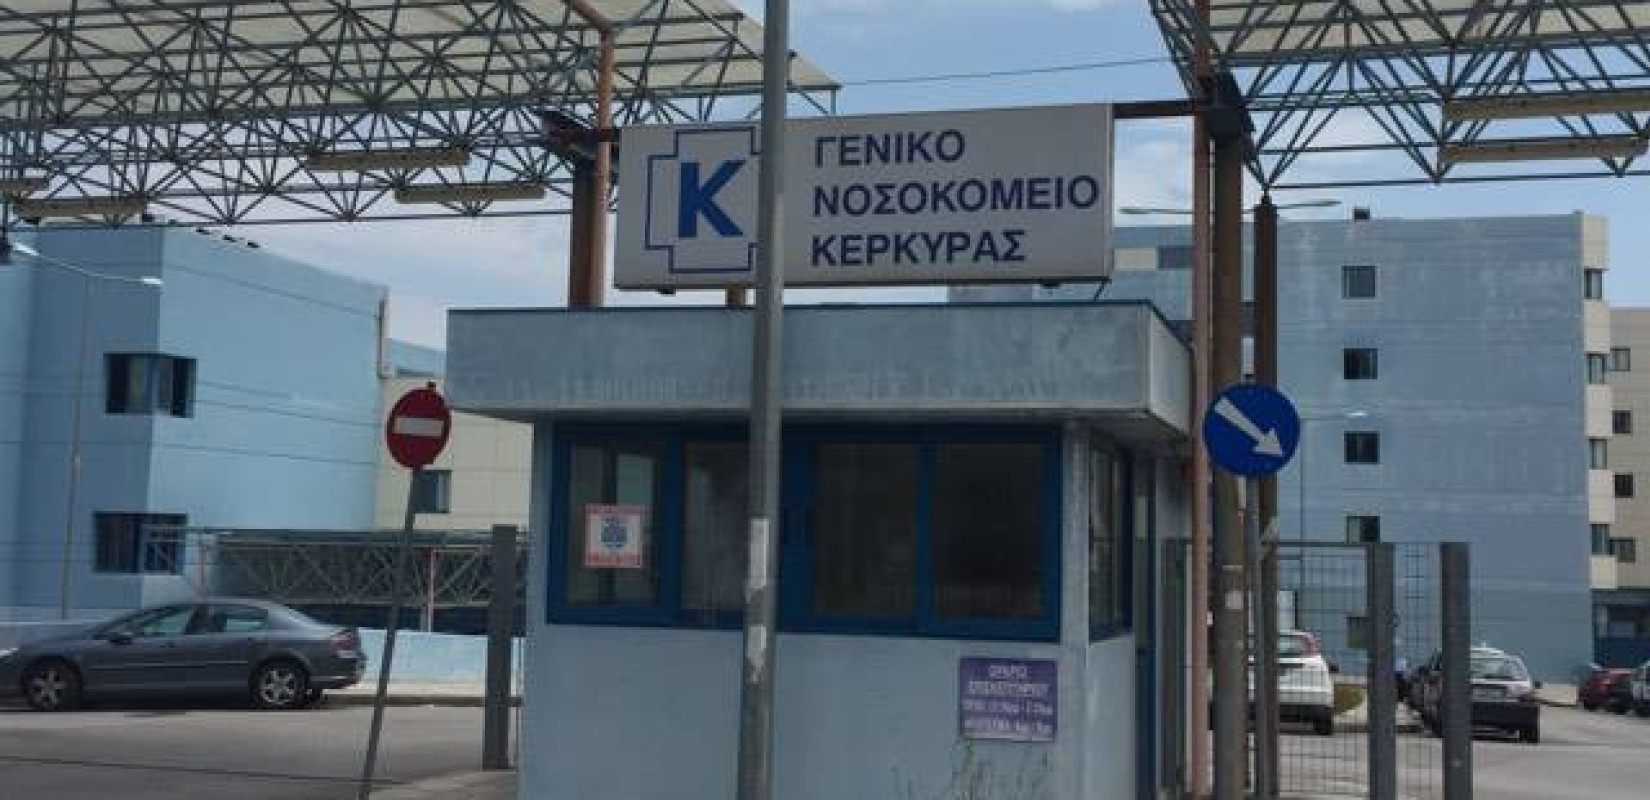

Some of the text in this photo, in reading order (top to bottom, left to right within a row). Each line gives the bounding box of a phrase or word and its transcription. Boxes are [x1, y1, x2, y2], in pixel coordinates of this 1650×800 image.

[814, 129, 966, 168] ΓΕΝΙΚΟ
[678, 160, 745, 237] Κ
[812, 175, 1099, 217] ΝΟΣΟΚΟΜΕΙΟ
[811, 229, 1027, 266] ΚΕΡΚΥΡΑΣ
